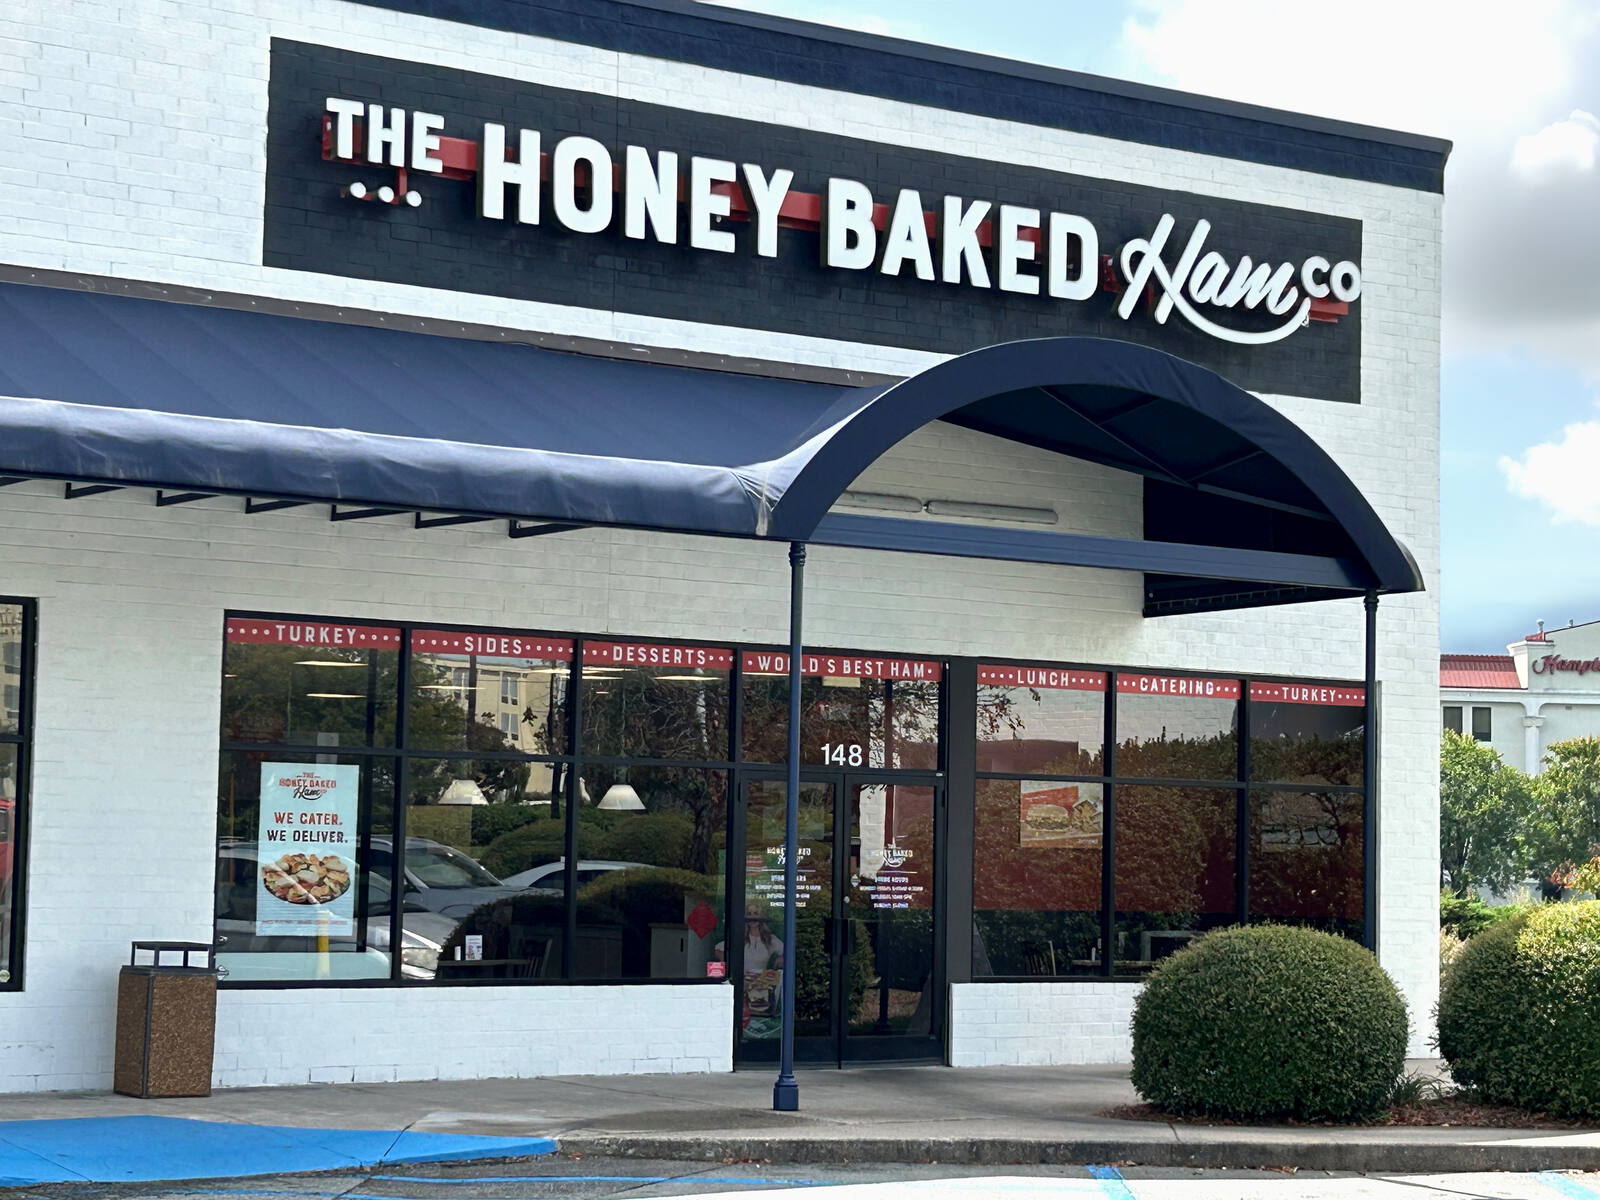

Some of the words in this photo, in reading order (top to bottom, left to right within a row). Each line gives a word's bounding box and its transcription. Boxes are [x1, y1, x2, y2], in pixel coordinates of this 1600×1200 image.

[326, 97, 445, 173] THE
[482, 122, 794, 258] HONEY
[828, 177, 1099, 301] BAKED
[1117, 213, 1311, 344] Ham
[275, 624, 357, 645] TURKEY
[464, 636, 522, 655] SIDES
[613, 645, 706, 665] DESSERTS
[757, 655, 836, 674] WOLD'S
[843, 659, 884, 675] BEST
[890, 662, 924, 678] HAM
[1531, 654, 1600, 676] Hampt
[1017, 669, 1069, 687] LUNCH
[1140, 677, 1214, 695] CATERING
[1281, 686, 1337, 703] TURKEY
[820, 743, 863, 767] 148
[274, 812, 294, 824] WE
[299, 812, 343, 825] CATER.
[266, 829, 287, 842] WE
[292, 830, 348, 843] DELIVER.
